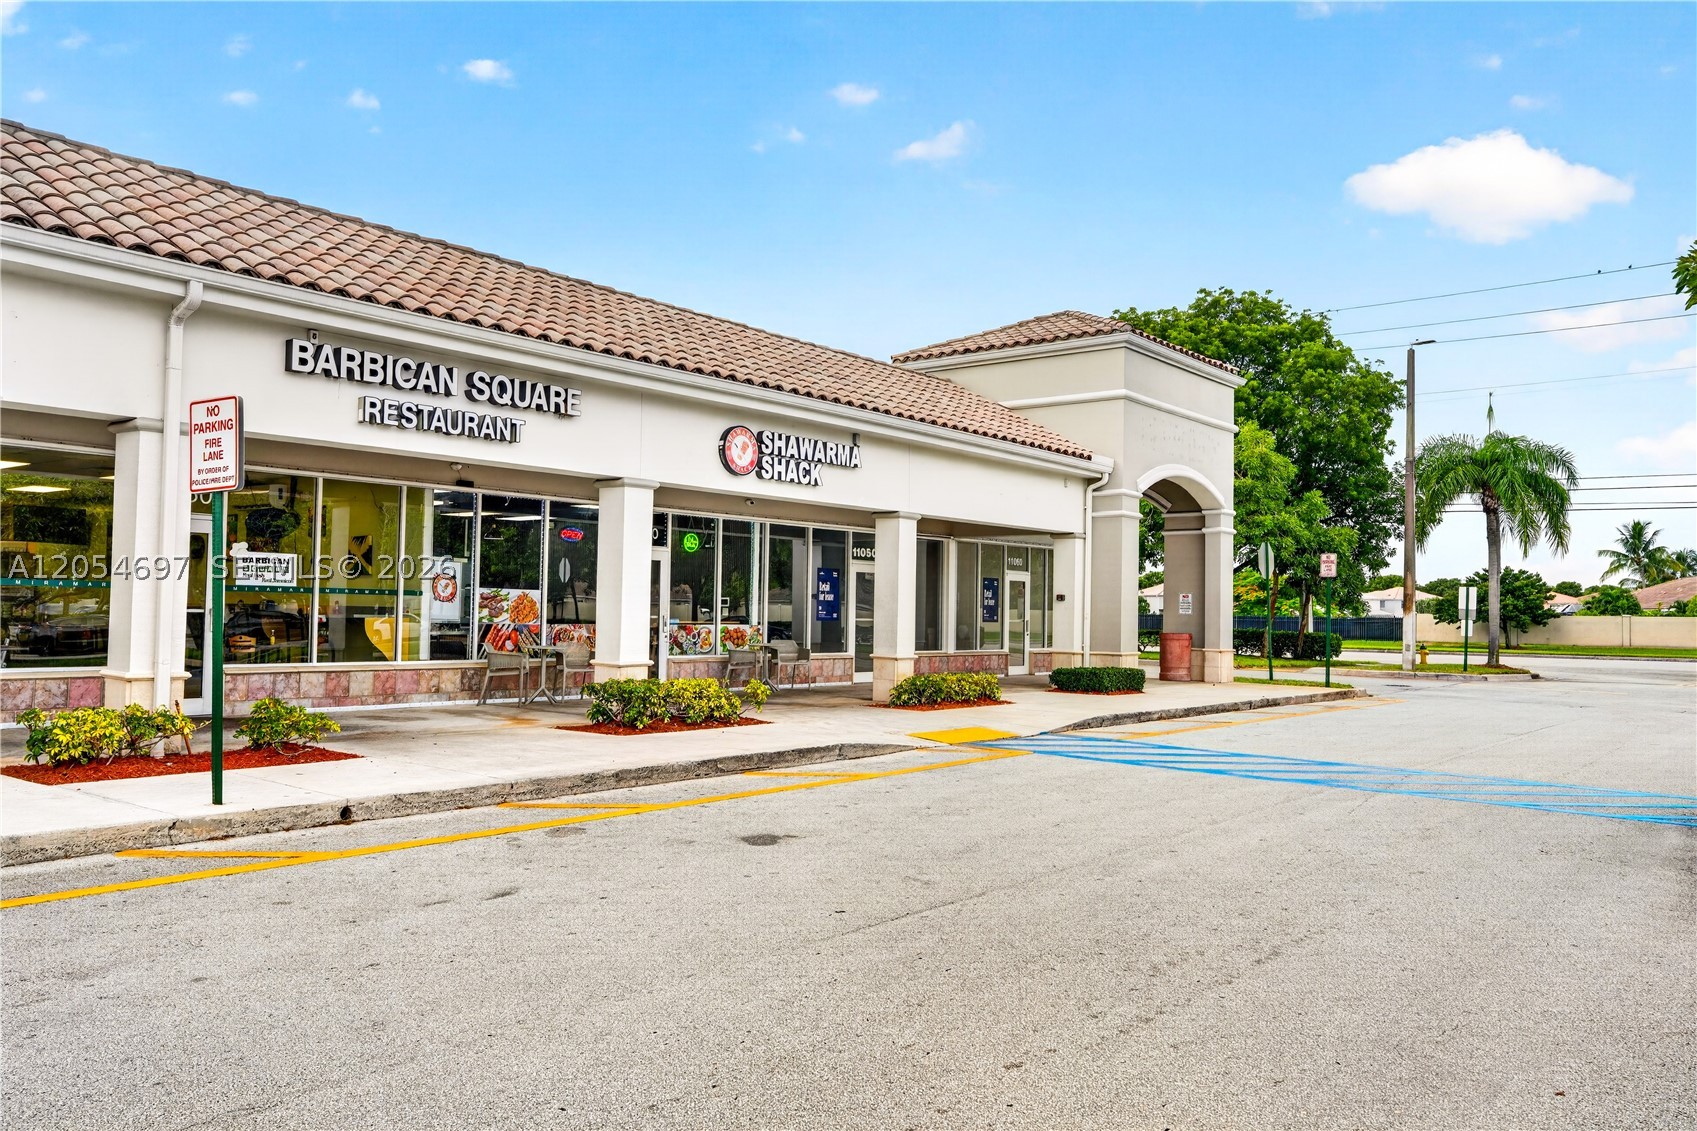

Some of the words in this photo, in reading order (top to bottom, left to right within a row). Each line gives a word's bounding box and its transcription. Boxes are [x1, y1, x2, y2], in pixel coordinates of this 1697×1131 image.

[287, 338, 458, 395] BARBICAN
[467, 371, 582, 417] SQUARE
[206, 404, 220, 417] NO
[360, 395, 526, 443] RESTAURANT
[193, 419, 233, 434] PARKING
[204, 437, 222, 449] FIRE
[759, 430, 861, 468] SHAWARMA
[202, 450, 224, 462] LANE
[204, 466, 222, 475] ORDER
[222, 465, 229, 473] OF
[758, 455, 823, 486] SHACK
[222, 475, 235, 483] DEPT
[561, 529, 583, 541] OPEN
[852, 547, 875, 558] 11050
[1008, 557, 1023, 566] 11060
[15, 579, 107, 587] MIRAMAR
